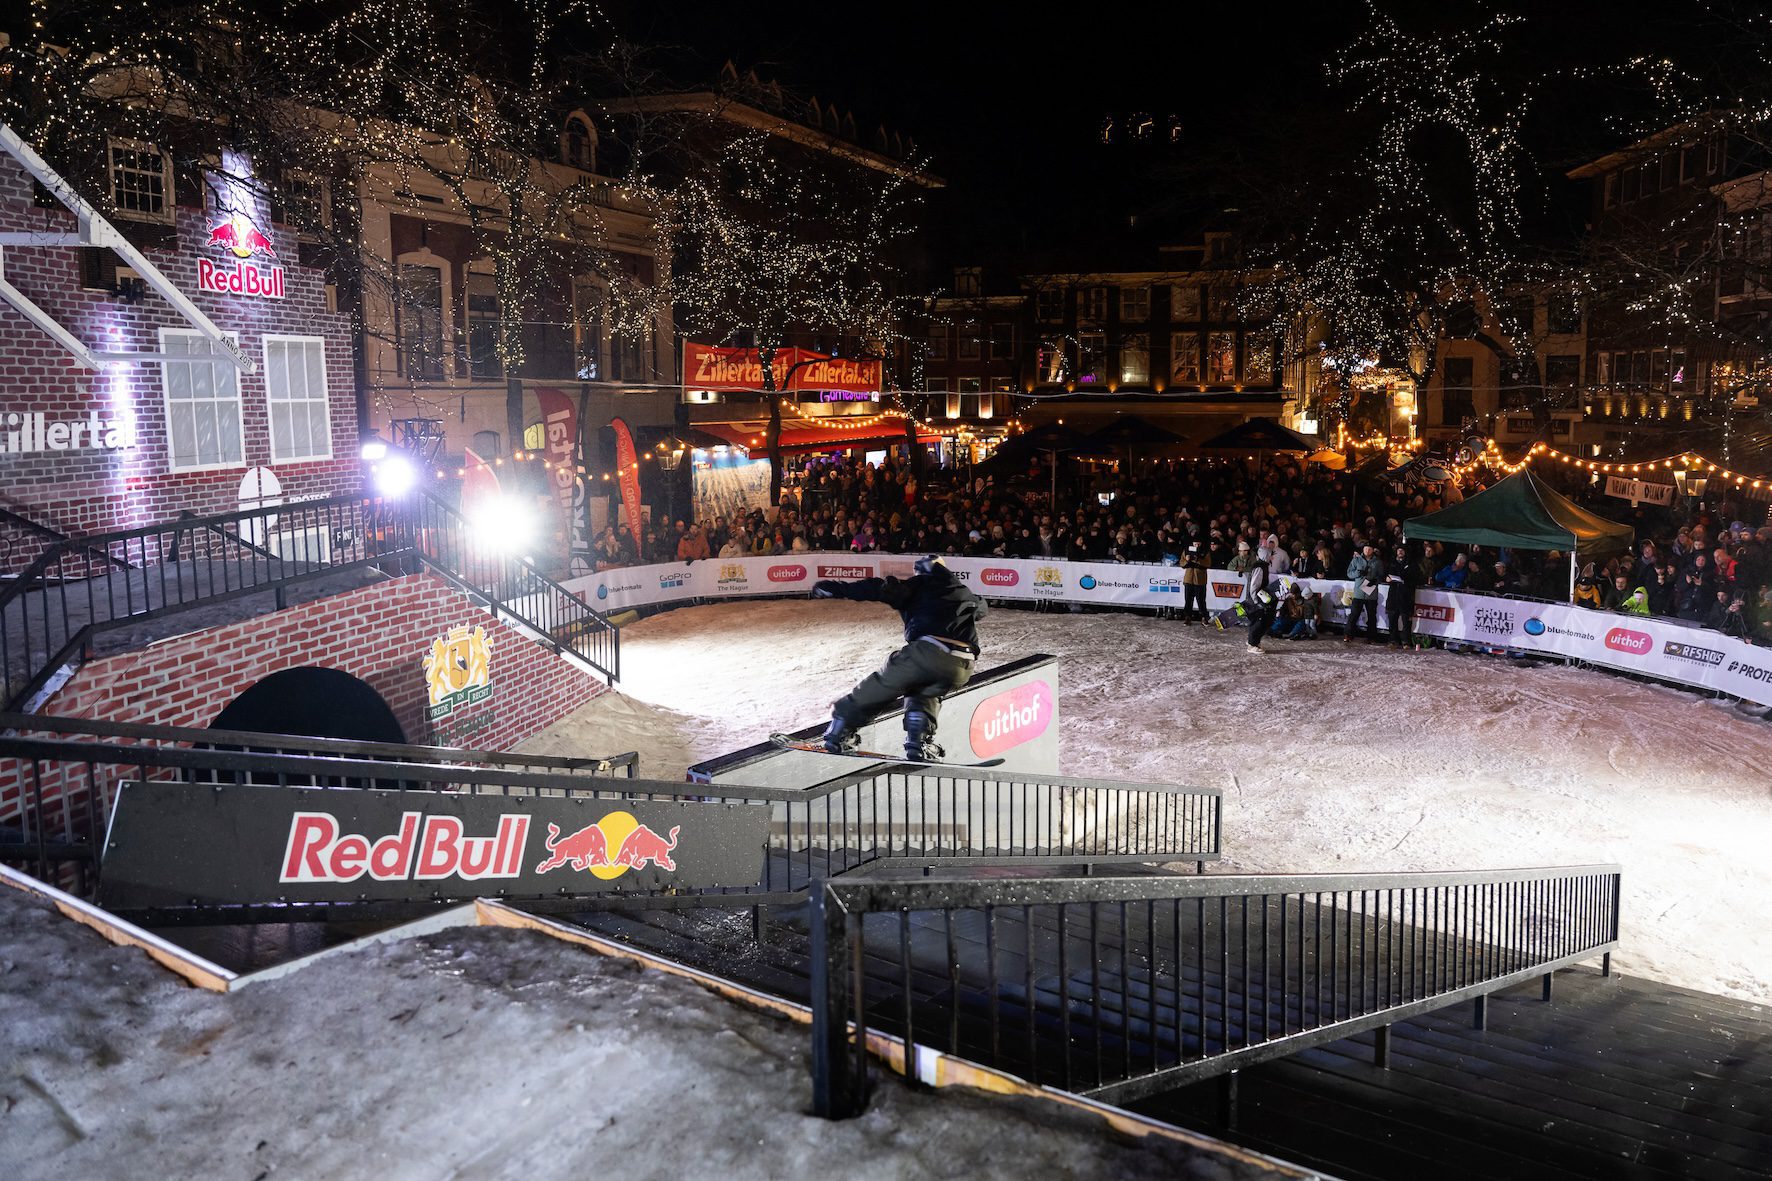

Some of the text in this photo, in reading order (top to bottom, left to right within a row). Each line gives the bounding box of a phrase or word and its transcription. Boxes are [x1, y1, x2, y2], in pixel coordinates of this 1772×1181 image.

[221, 336, 239, 355] ANNO
[0, 409, 136, 453] illertal
[660, 572, 692, 582] GoPro
[773, 568, 800, 578] uithof
[825, 567, 866, 578] Zillertal
[986, 573, 1013, 582] uithof
[1098, 580, 1140, 588] blue-tomato
[1149, 577, 1183, 586] GoPr
[1475, 608, 1514, 619] GROTE
[1475, 618, 1514, 630] MARKT
[1547, 626, 1595, 641] blue-tomato
[1611, 633, 1645, 648] uithof
[472, 688, 489, 701] RECHT
[983, 693, 1041, 742] uithof
